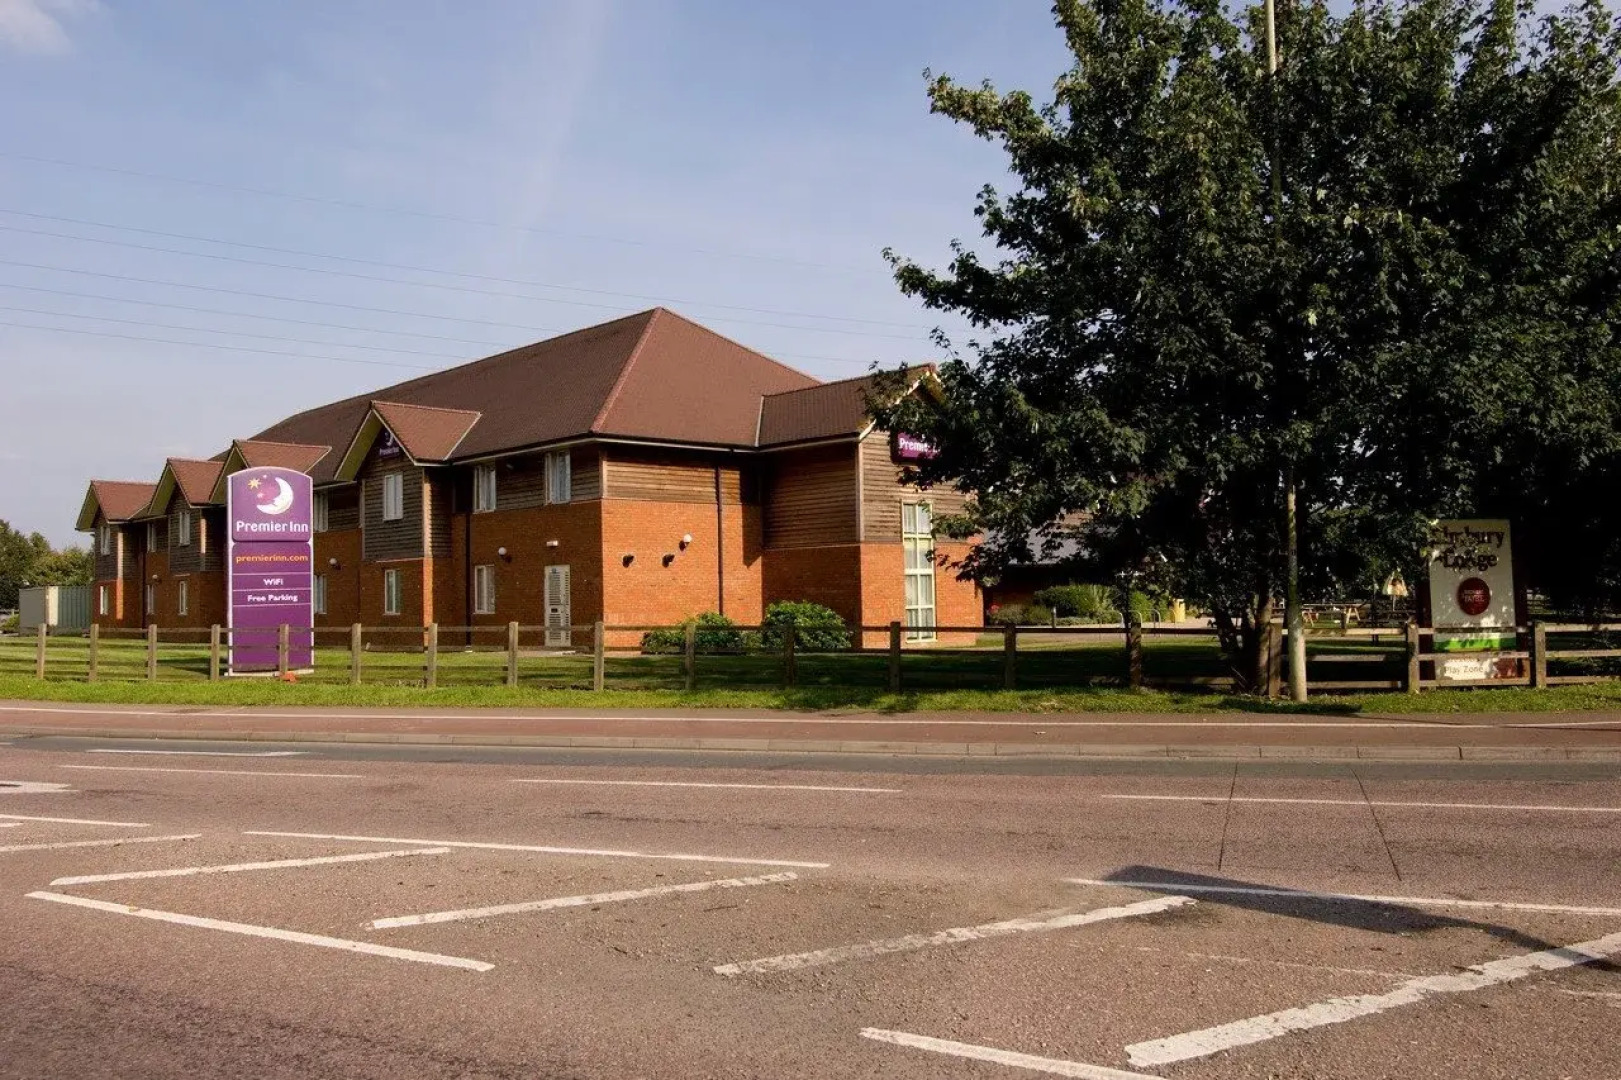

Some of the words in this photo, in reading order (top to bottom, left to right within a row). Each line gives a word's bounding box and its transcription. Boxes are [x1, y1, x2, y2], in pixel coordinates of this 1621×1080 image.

[236, 521, 287, 532] Premier
[289, 521, 309, 532] Inn
[236, 554, 308, 563] premierinn.com
[263, 578, 283, 586] WiFi
[247, 594, 266, 602] Free
[268, 594, 298, 602] Parking
[1445, 666, 1460, 676] Play
[1463, 665, 1484, 673] Zone
